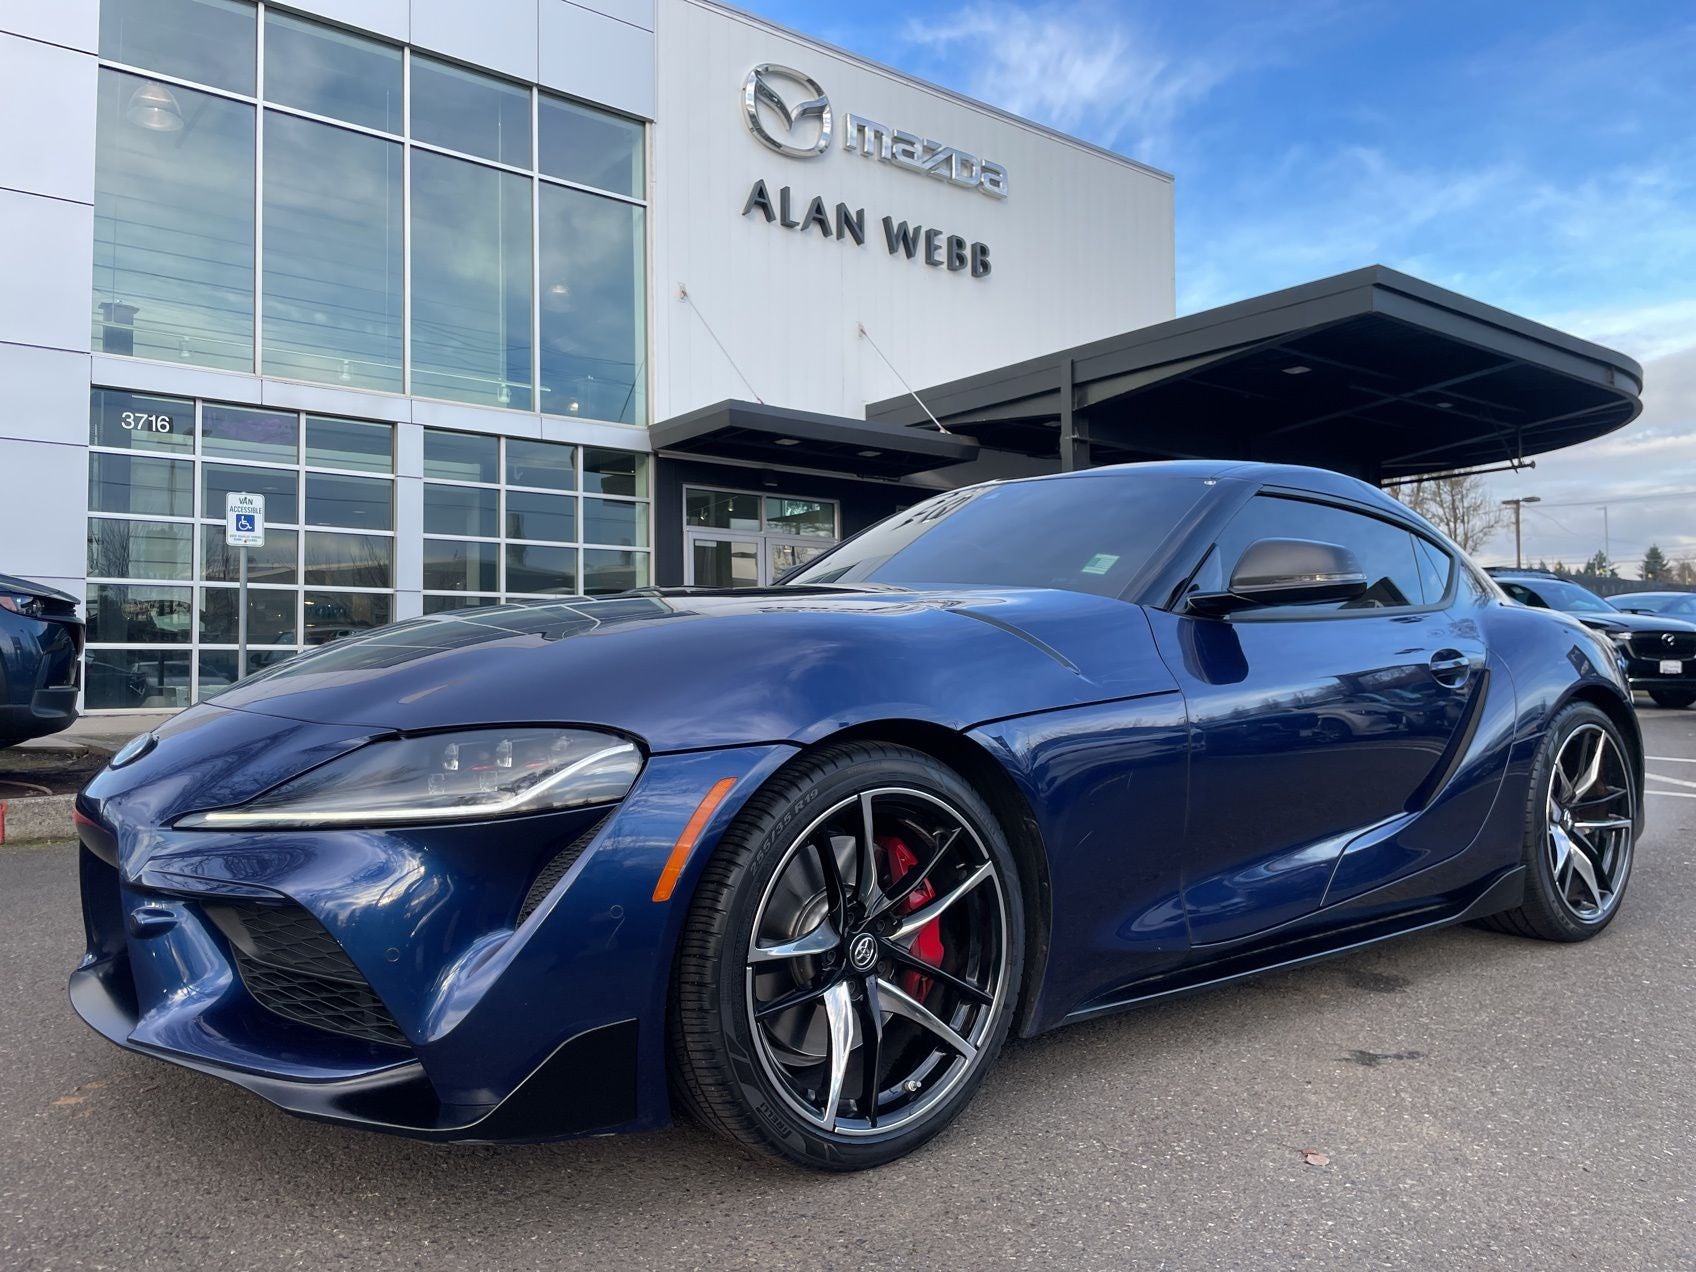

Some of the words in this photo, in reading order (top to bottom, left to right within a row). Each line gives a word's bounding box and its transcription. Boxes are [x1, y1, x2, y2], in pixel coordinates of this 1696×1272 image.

[742, 178, 865, 246] ALAN
[882, 215, 992, 278] WEBB
[121, 411, 170, 433] 3716
[230, 506, 262, 514] ACCESSIBLE
[239, 497, 253, 505] VAN
[794, 788, 819, 814] R19
[755, 1102, 793, 1139] PIRELLI
